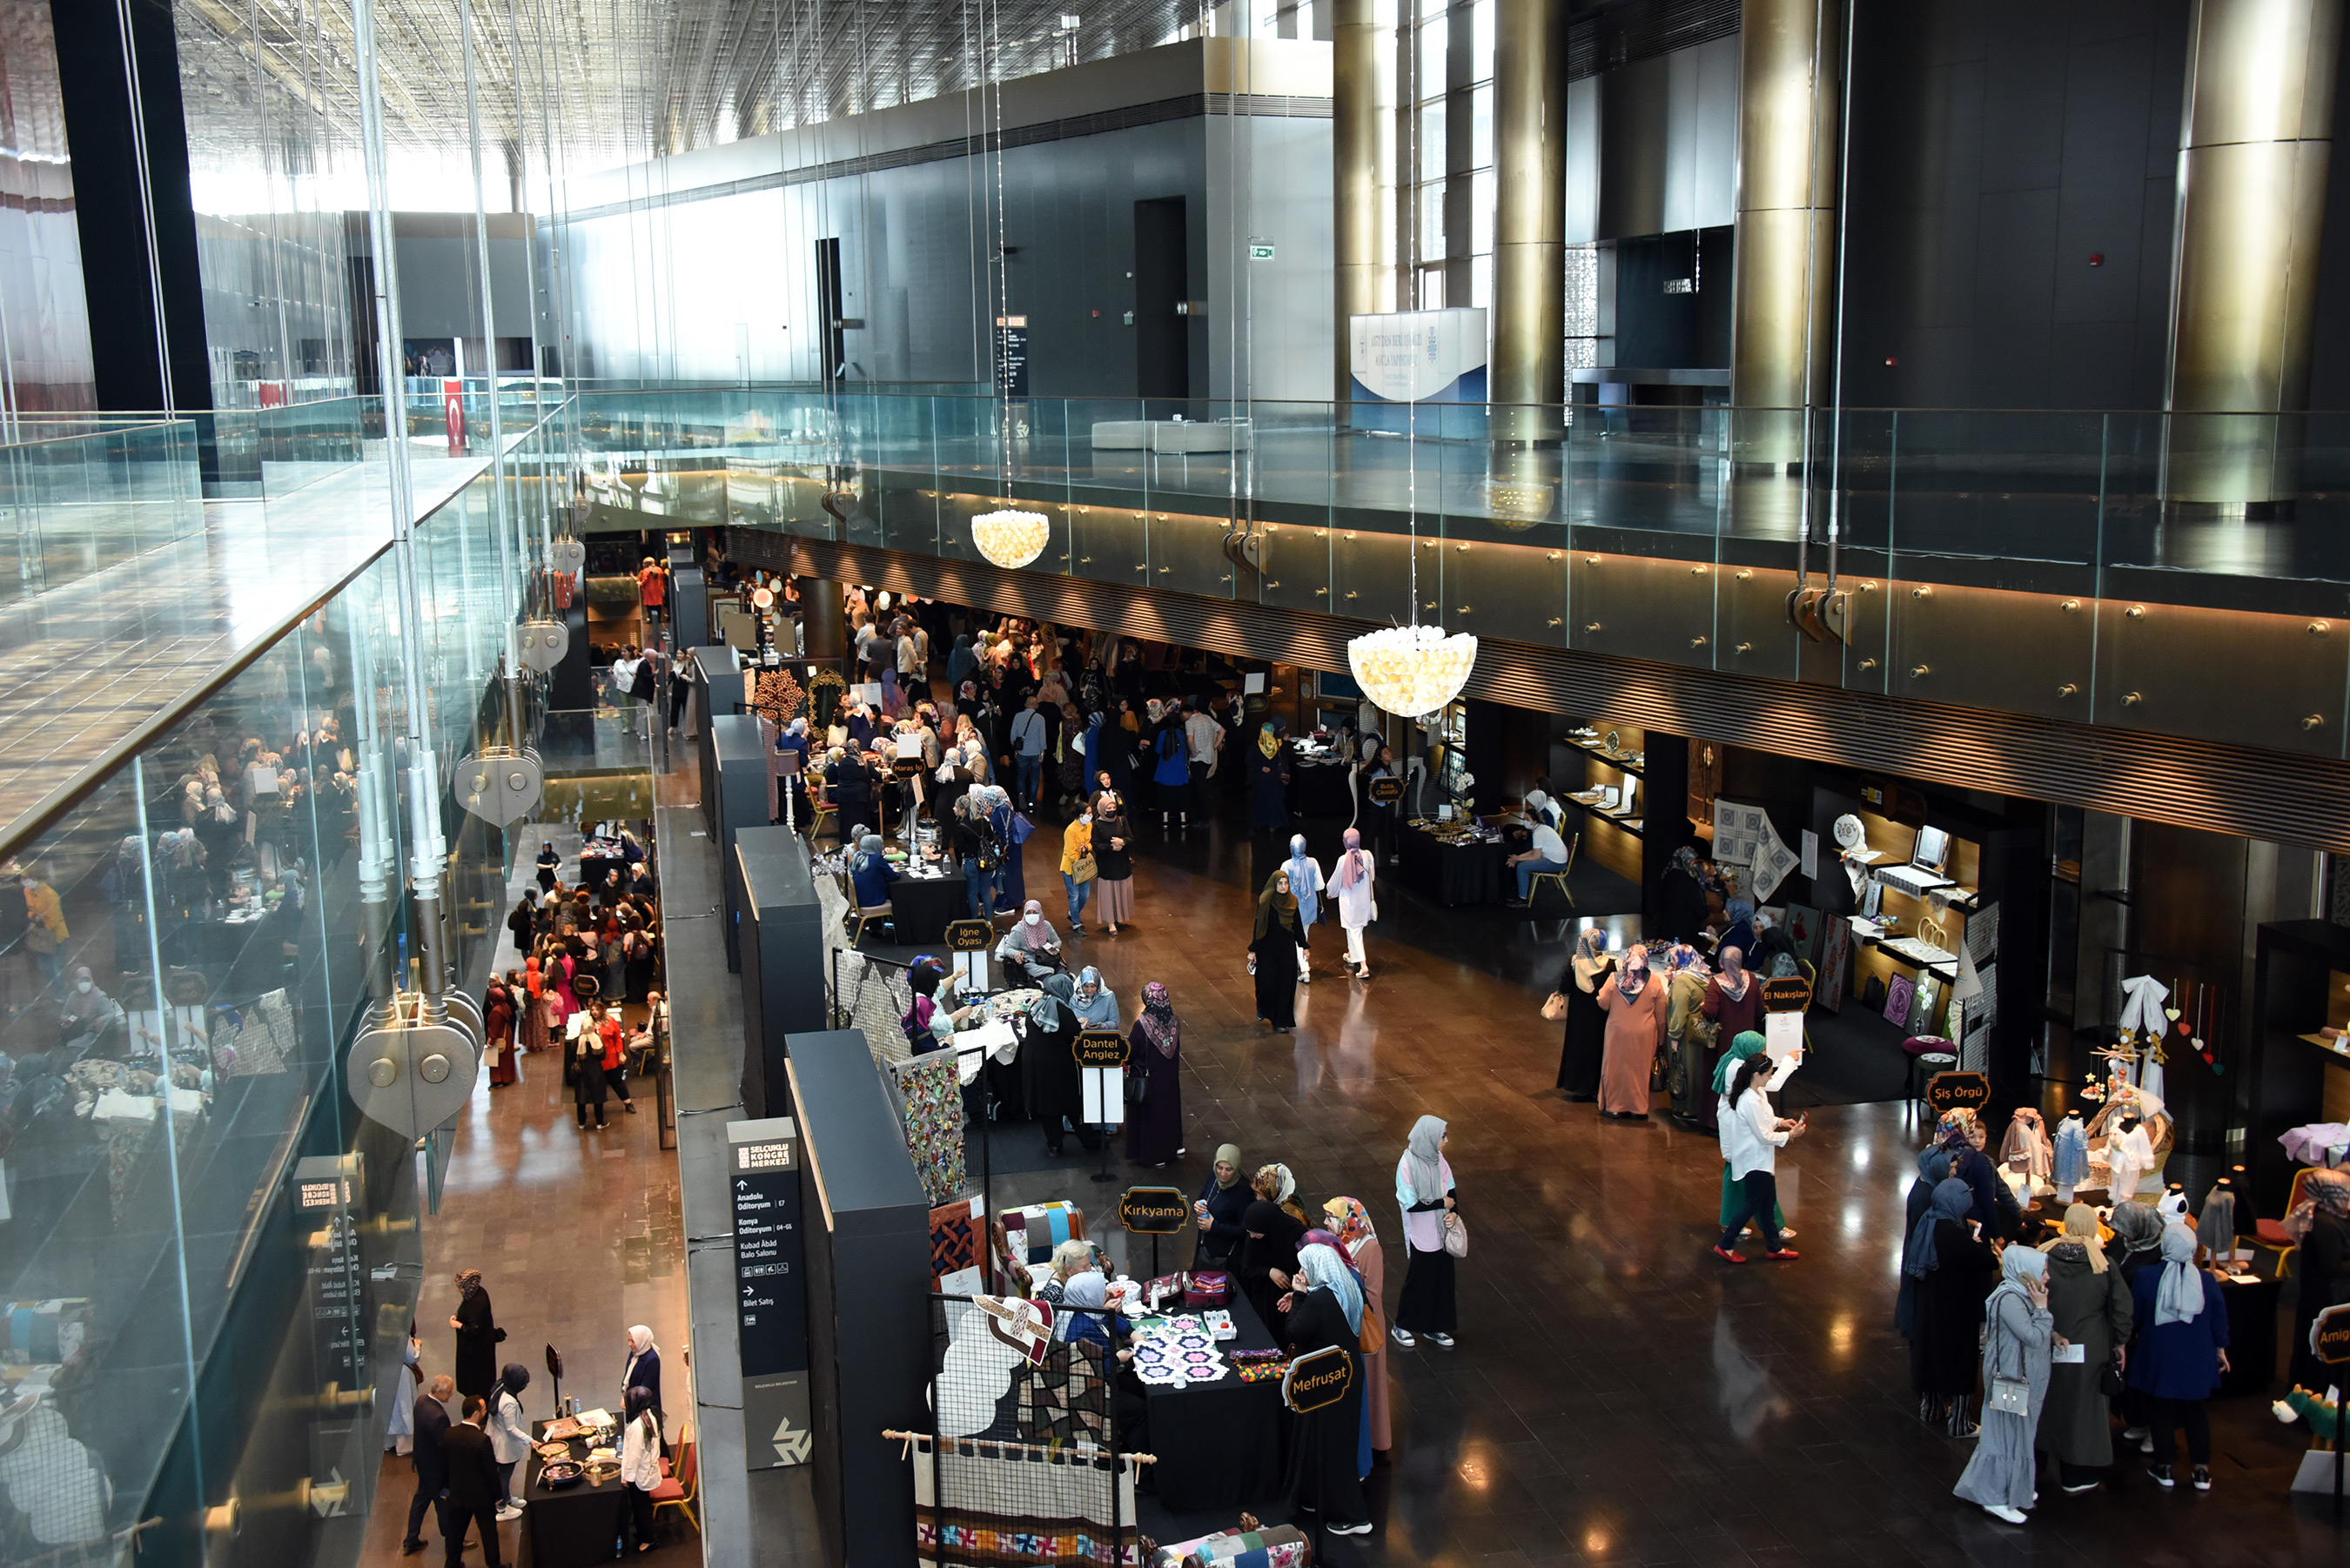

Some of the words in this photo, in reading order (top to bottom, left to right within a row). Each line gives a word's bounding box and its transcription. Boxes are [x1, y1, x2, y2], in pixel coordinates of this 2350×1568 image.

[957, 937, 982, 946] Oyası
[1774, 990, 1809, 1000] Nakışları
[1083, 1039, 1118, 1049] Dantel
[1083, 1049, 1120, 1060] Anglez
[1935, 1088, 1951, 1100] Şiş
[1954, 1085, 1983, 1098] Örgü
[750, 1143, 789, 1154] SELÇUKLU
[750, 1150, 789, 1160] KONGRE
[751, 1156, 789, 1168] MERKEZİ
[737, 1202, 771, 1210] Oditoryum
[1124, 1204, 1185, 1217] Kırkyama
[739, 1226, 772, 1235] Oditoryum
[740, 1241, 760, 1250] Kubad
[1293, 1366, 1346, 1395] Mefruşat
